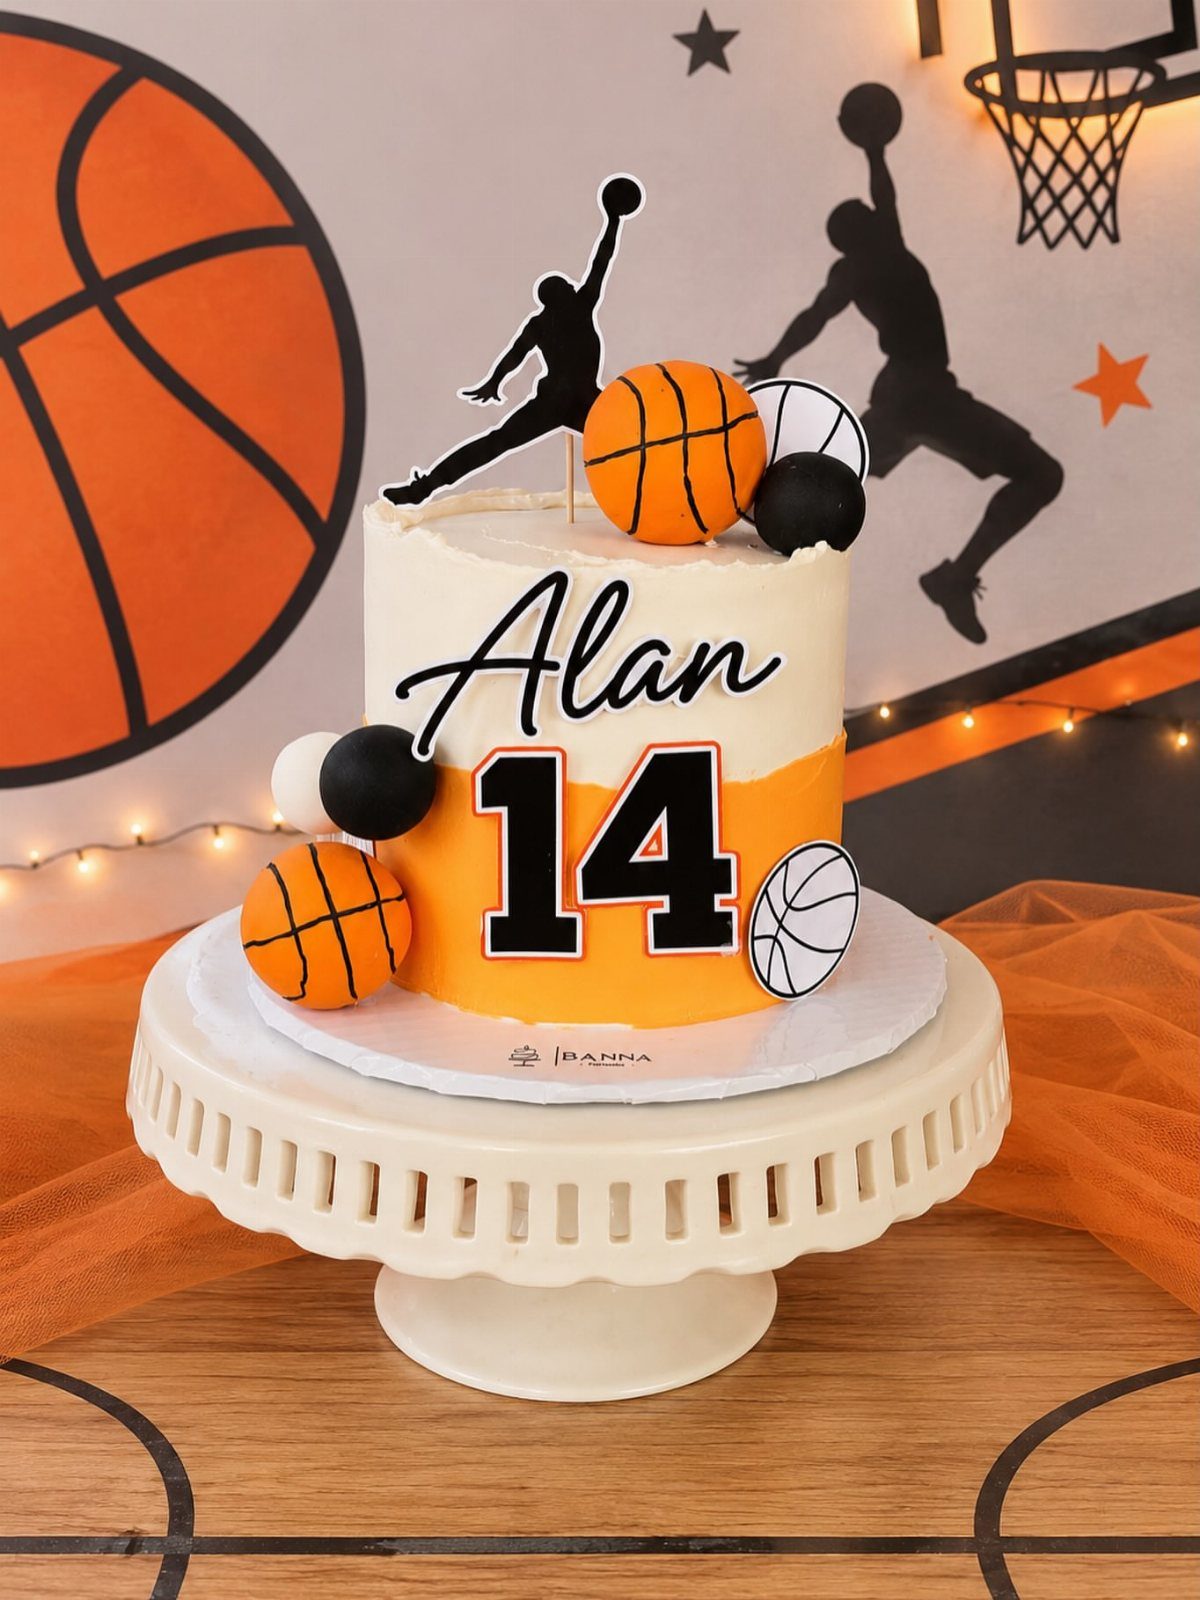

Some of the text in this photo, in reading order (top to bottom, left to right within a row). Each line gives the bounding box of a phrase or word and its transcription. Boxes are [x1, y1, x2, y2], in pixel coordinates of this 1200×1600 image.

[395, 569, 783, 757] Alan
[472, 742, 739, 959] 14
[562, 1051, 652, 1062] BANNA
